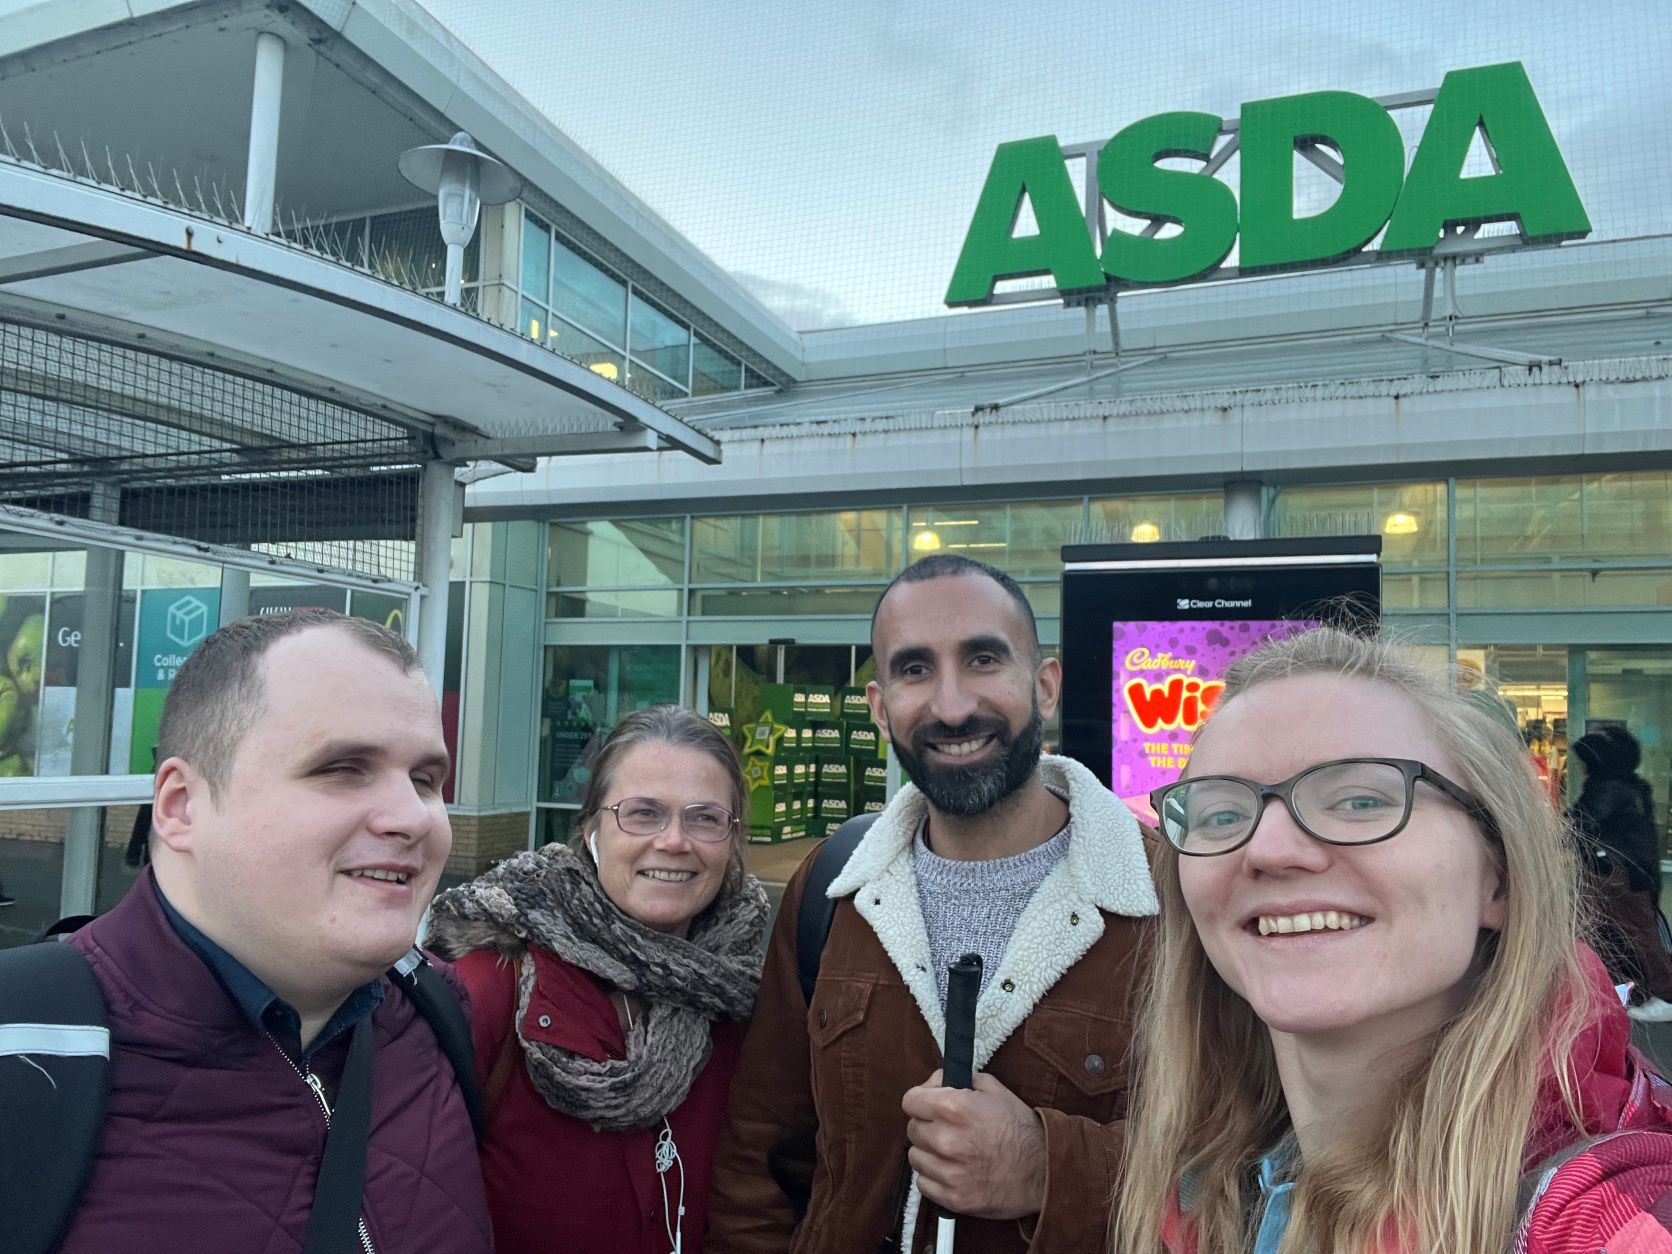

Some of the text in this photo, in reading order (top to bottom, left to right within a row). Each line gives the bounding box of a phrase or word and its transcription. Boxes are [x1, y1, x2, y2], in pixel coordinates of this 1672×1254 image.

[945, 60, 1592, 307] ASDA
[1190, 598, 1252, 608] Clear Channel
[1125, 647, 1196, 675] Cadbury
[156, 668, 165, 681] &
[807, 693, 830, 703] ASDA
[844, 695, 867, 704] ASDA
[1124, 674, 1227, 734] Wis
[814, 728, 840, 738] ASDA
[851, 730, 875, 740] ASDA
[1144, 742, 1168, 755] THE
[1149, 756, 1174, 768] THE
[822, 764, 847, 773] ASDA
[822, 799, 847, 808] ASDA
